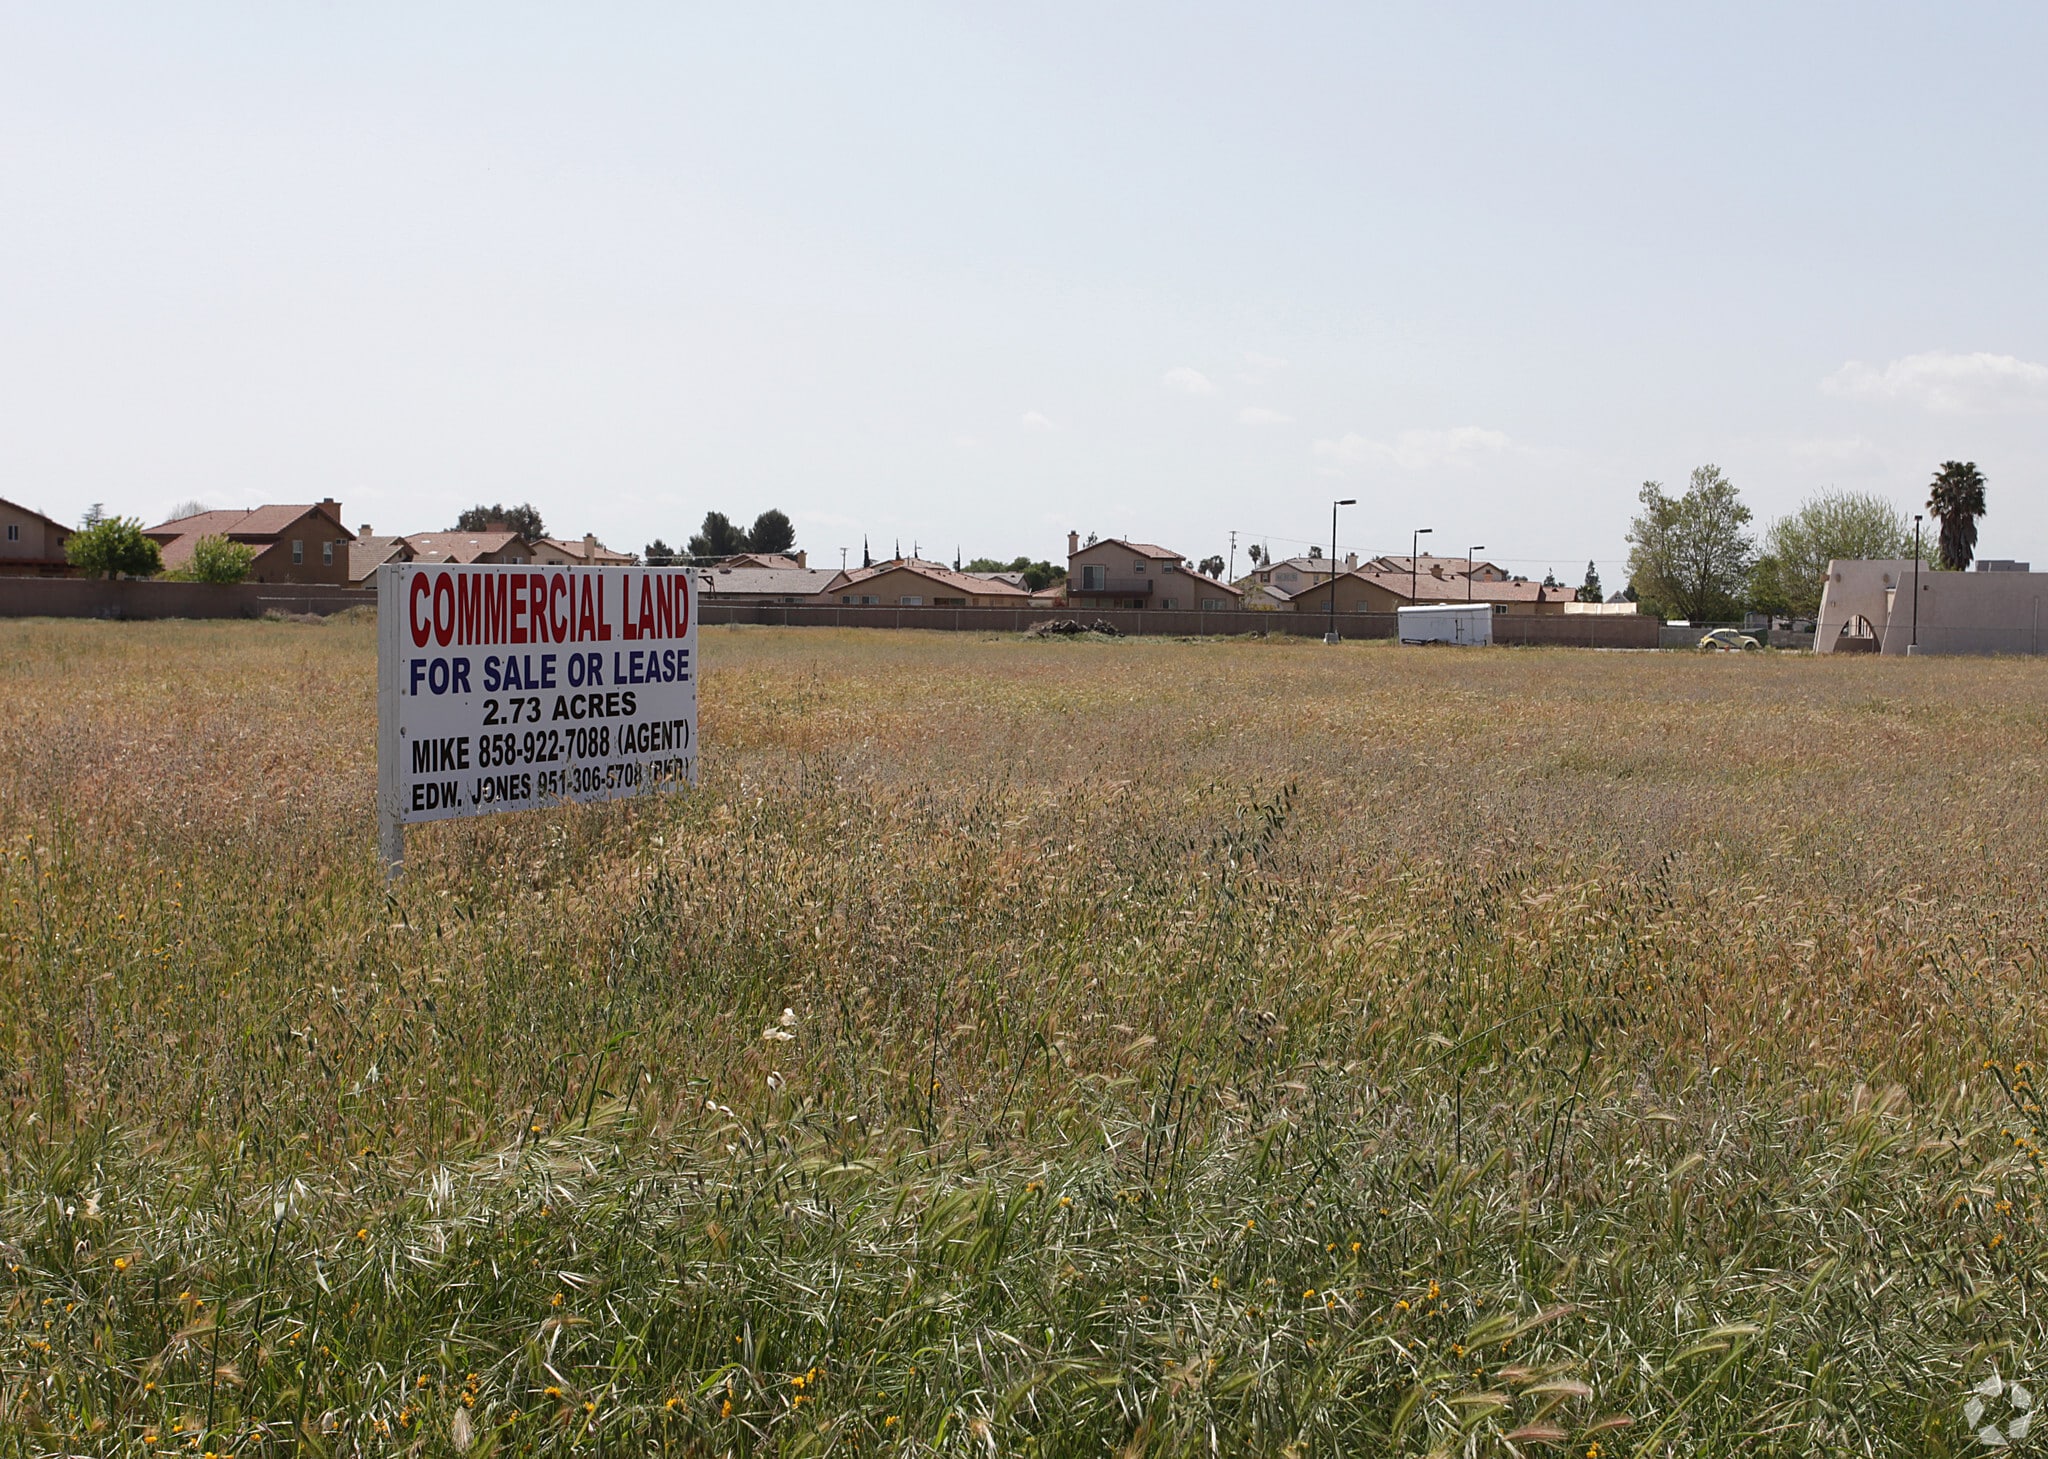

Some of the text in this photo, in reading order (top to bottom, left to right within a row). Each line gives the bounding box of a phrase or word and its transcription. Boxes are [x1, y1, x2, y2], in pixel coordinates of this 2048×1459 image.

[409, 571, 689, 648] COMMERCIAL LAND
[410, 649, 690, 696] FOR SALE OR LEASE
[482, 691, 638, 726] 2.73 ACRES
[412, 719, 690, 774] MIKE 858-922-7088 (AGENT)
[412, 780, 463, 812] EDW.
[471, 772, 531, 804] JONES
[537, 762, 643, 797] 951-306-5708
